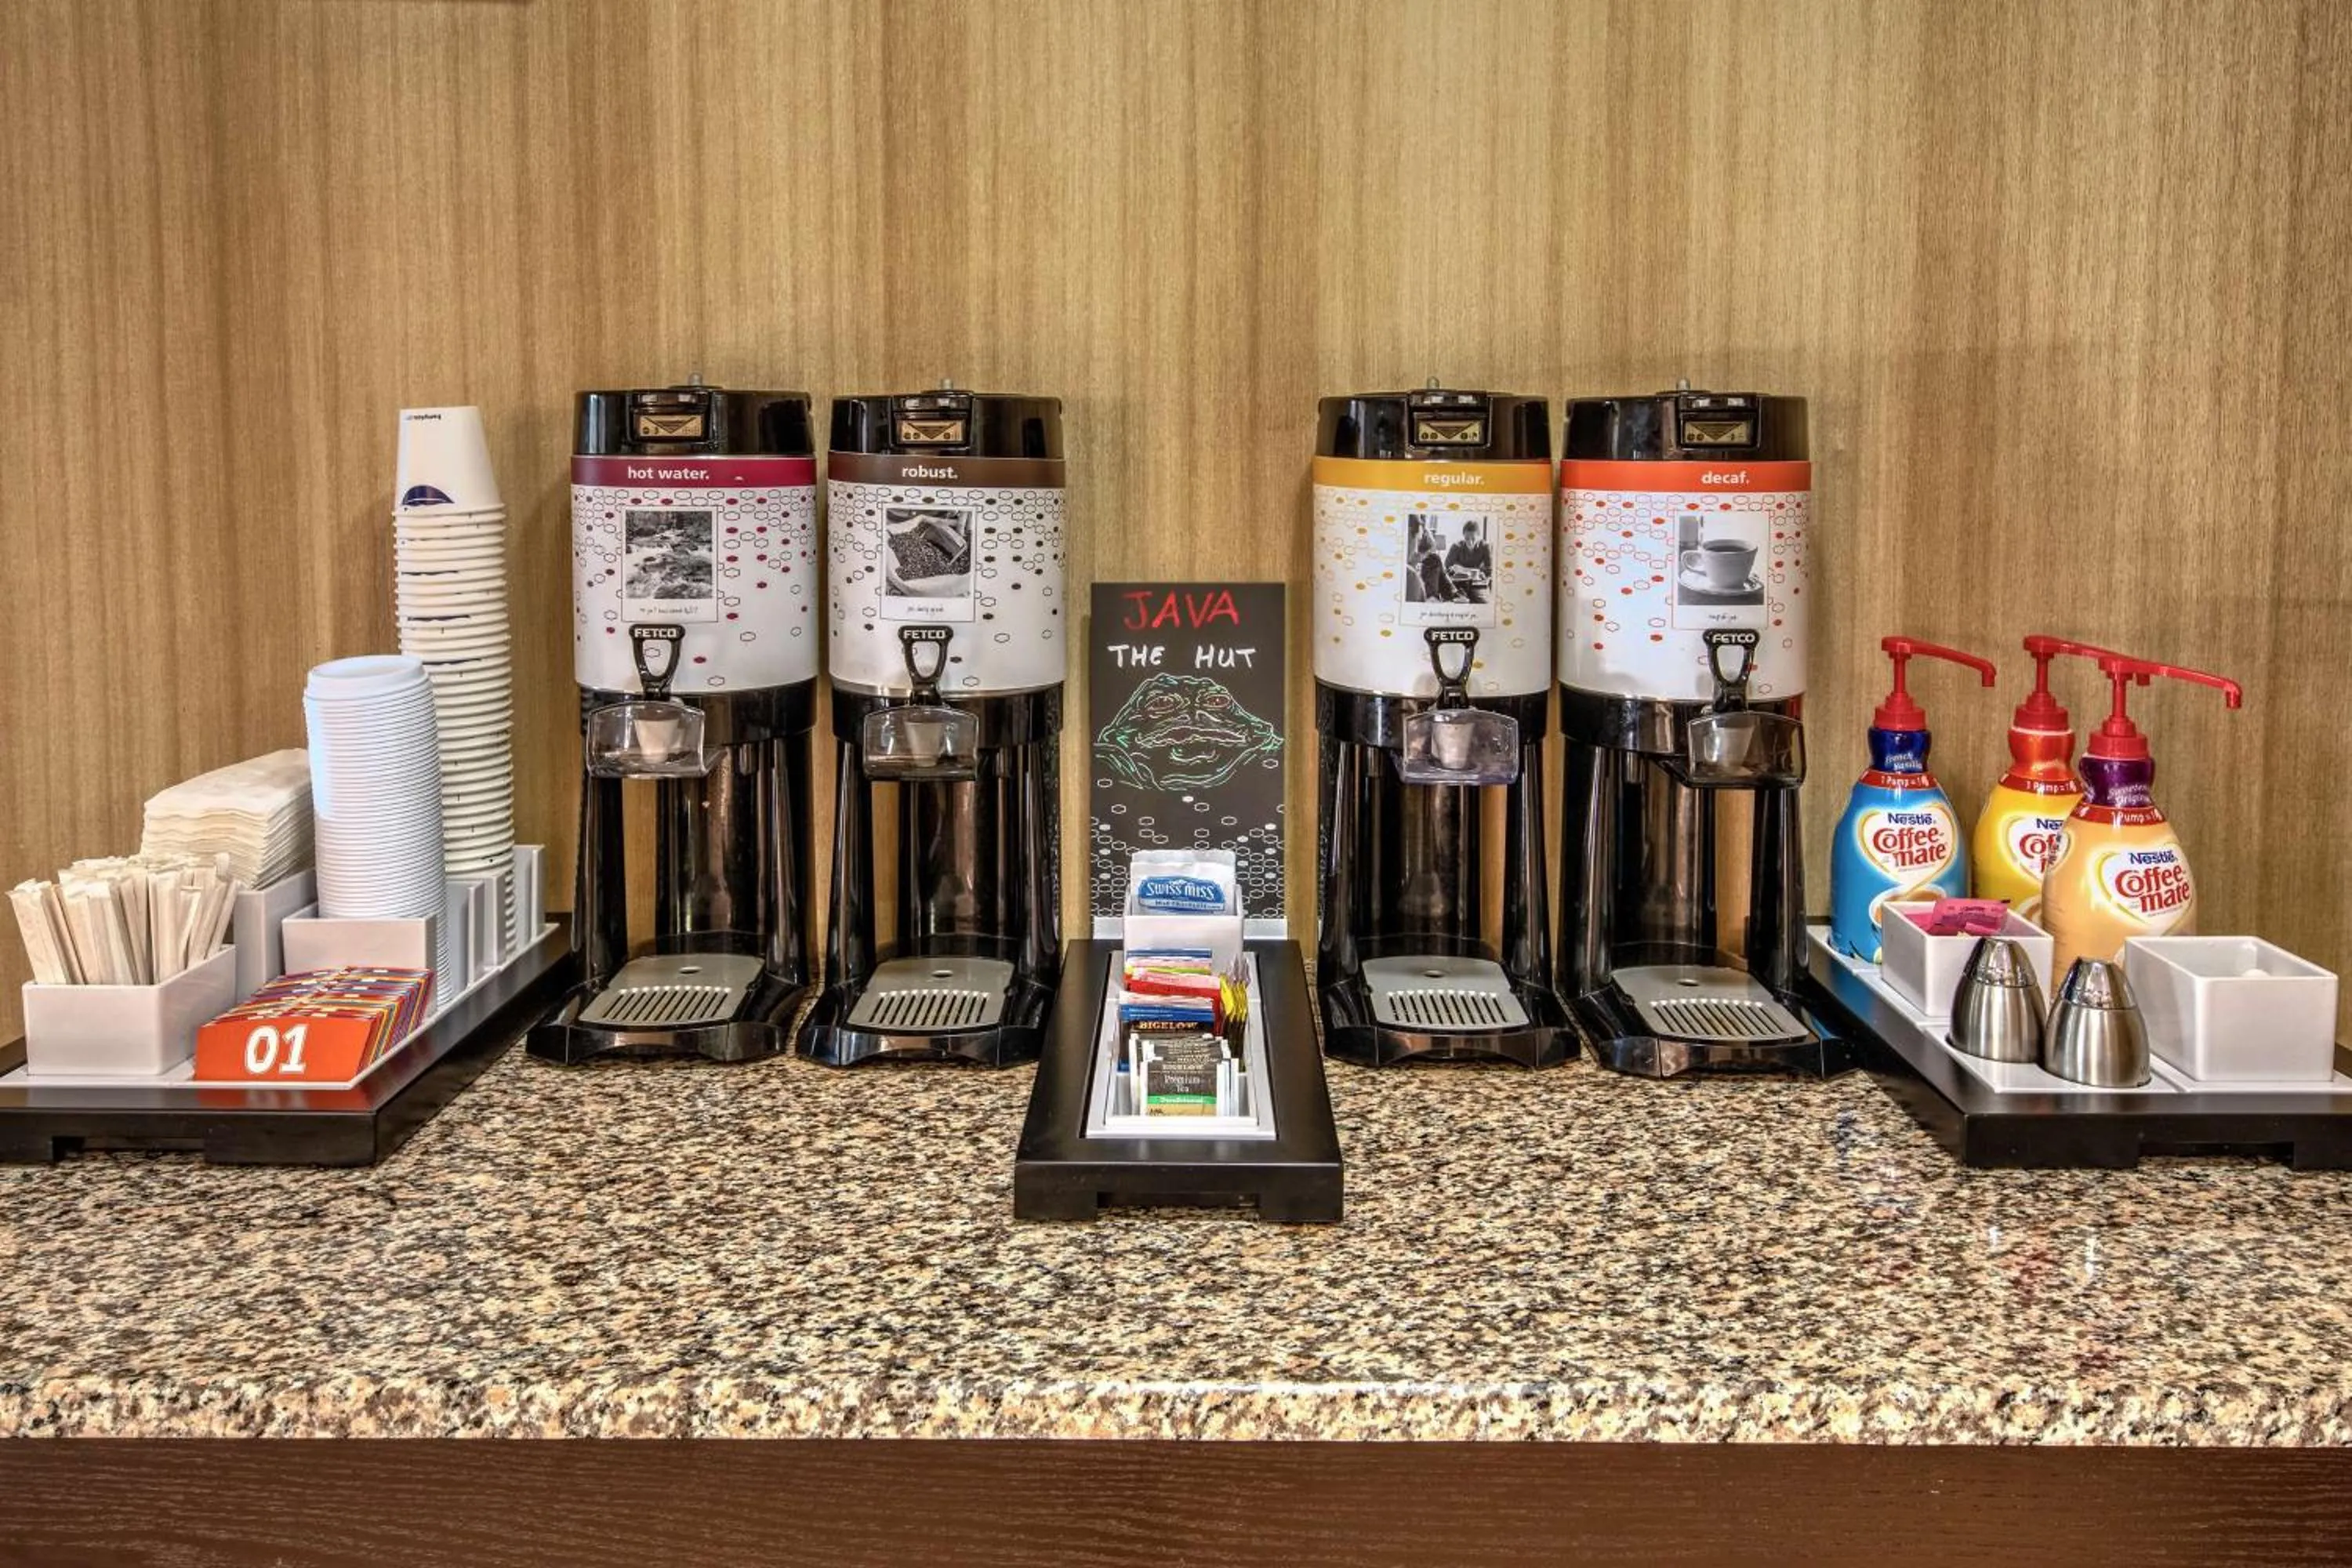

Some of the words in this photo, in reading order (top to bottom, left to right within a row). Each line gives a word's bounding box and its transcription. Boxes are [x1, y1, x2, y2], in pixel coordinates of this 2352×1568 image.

[628, 466, 654, 479] hot
[659, 468, 710, 480] water.
[902, 465, 957, 479] robust.
[1424, 471, 1485, 487] regular.
[1701, 470, 1750, 485] decaf.
[1123, 590, 1241, 630] JAVA
[634, 628, 677, 638] FETCO
[904, 630, 946, 639] FETCO
[1432, 631, 1474, 641] FETCO
[1713, 633, 1755, 644] FETCO
[1107, 644, 1165, 668] THE
[1194, 644, 1256, 669] HUT
[1893, 843, 1946, 866] mate
[2140, 880, 2190, 913] mate
[245, 1023, 308, 1074] 01
